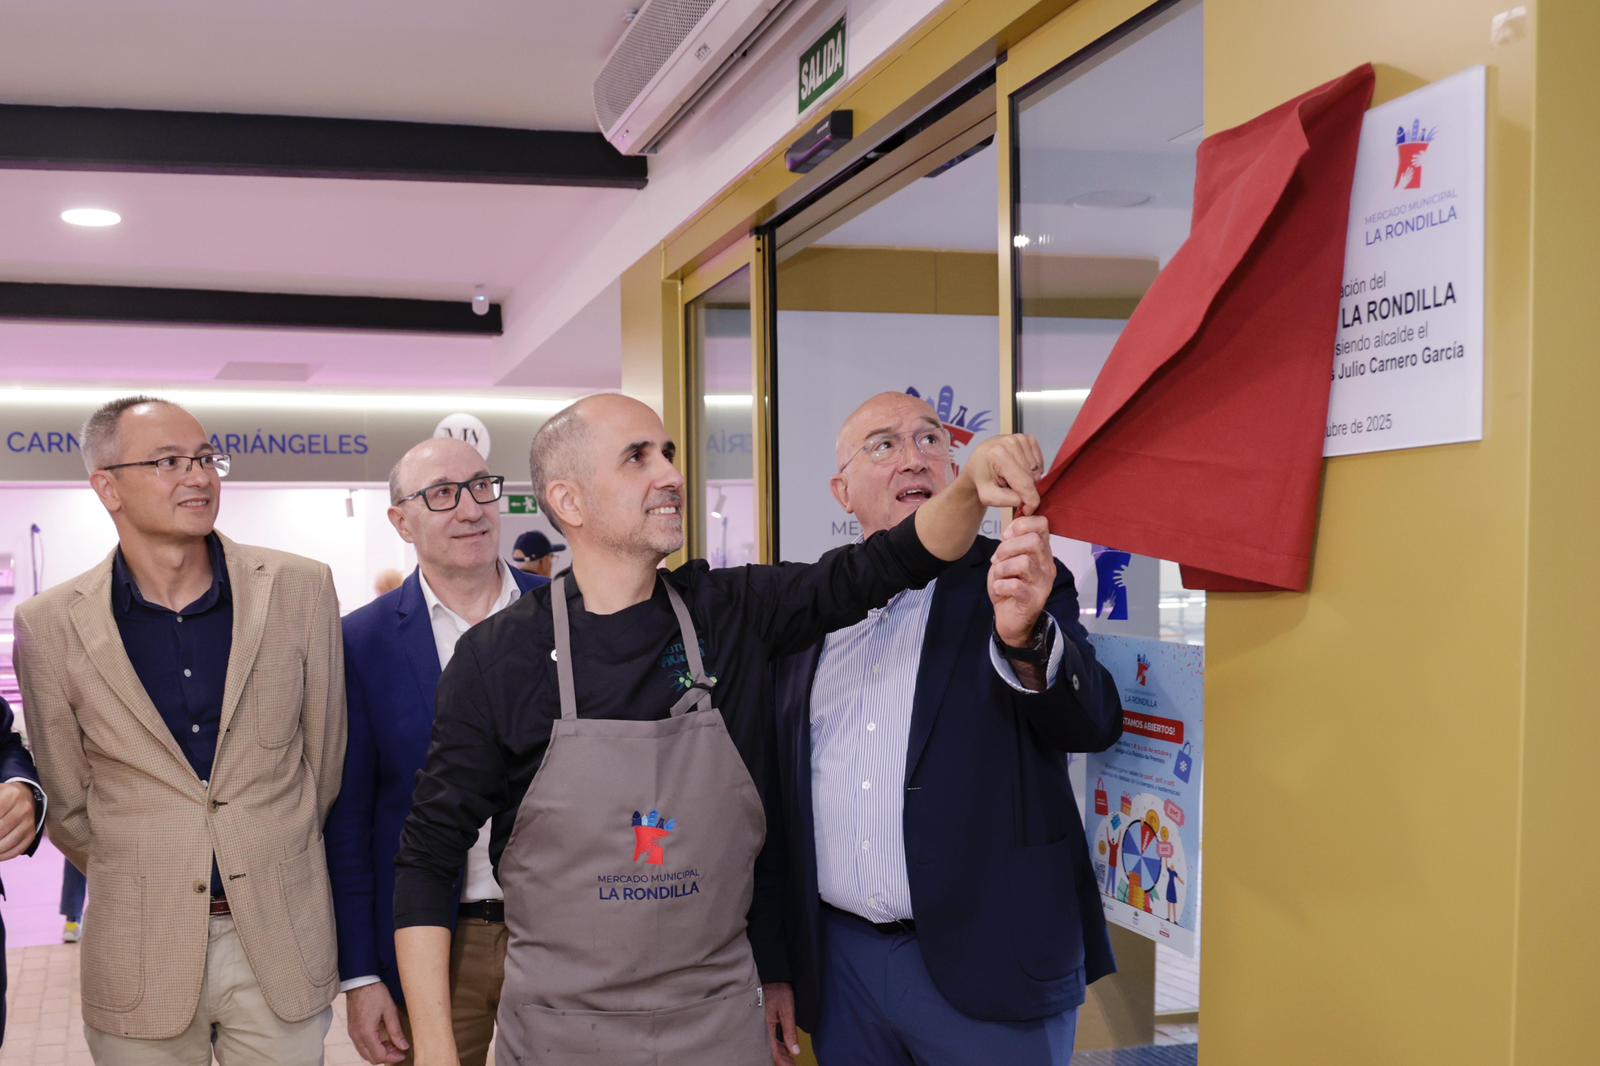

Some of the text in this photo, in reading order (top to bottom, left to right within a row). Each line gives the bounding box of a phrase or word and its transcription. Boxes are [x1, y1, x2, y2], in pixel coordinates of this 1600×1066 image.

[801, 30, 842, 101] SALIDA
[1364, 188, 1458, 224] MERCADO MUNICIPAL
[1365, 206, 1457, 246] LA RONDILLA
[1370, 270, 1386, 290] del
[1341, 281, 1457, 328] LA RONDILLA
[1335, 320, 1428, 356] siendo alcalde el
[1338, 359, 1366, 380] Julio
[1370, 352, 1418, 374] Carnero
[1421, 341, 1465, 364] García
[1350, 418, 1364, 434] de
[1366, 413, 1393, 433] 2025
[1144, 721, 1176, 736] ABIERTOS!
[597, 869, 700, 884] MERCADO MUNICIPAL
[599, 881, 700, 901] LA RONDILLA
